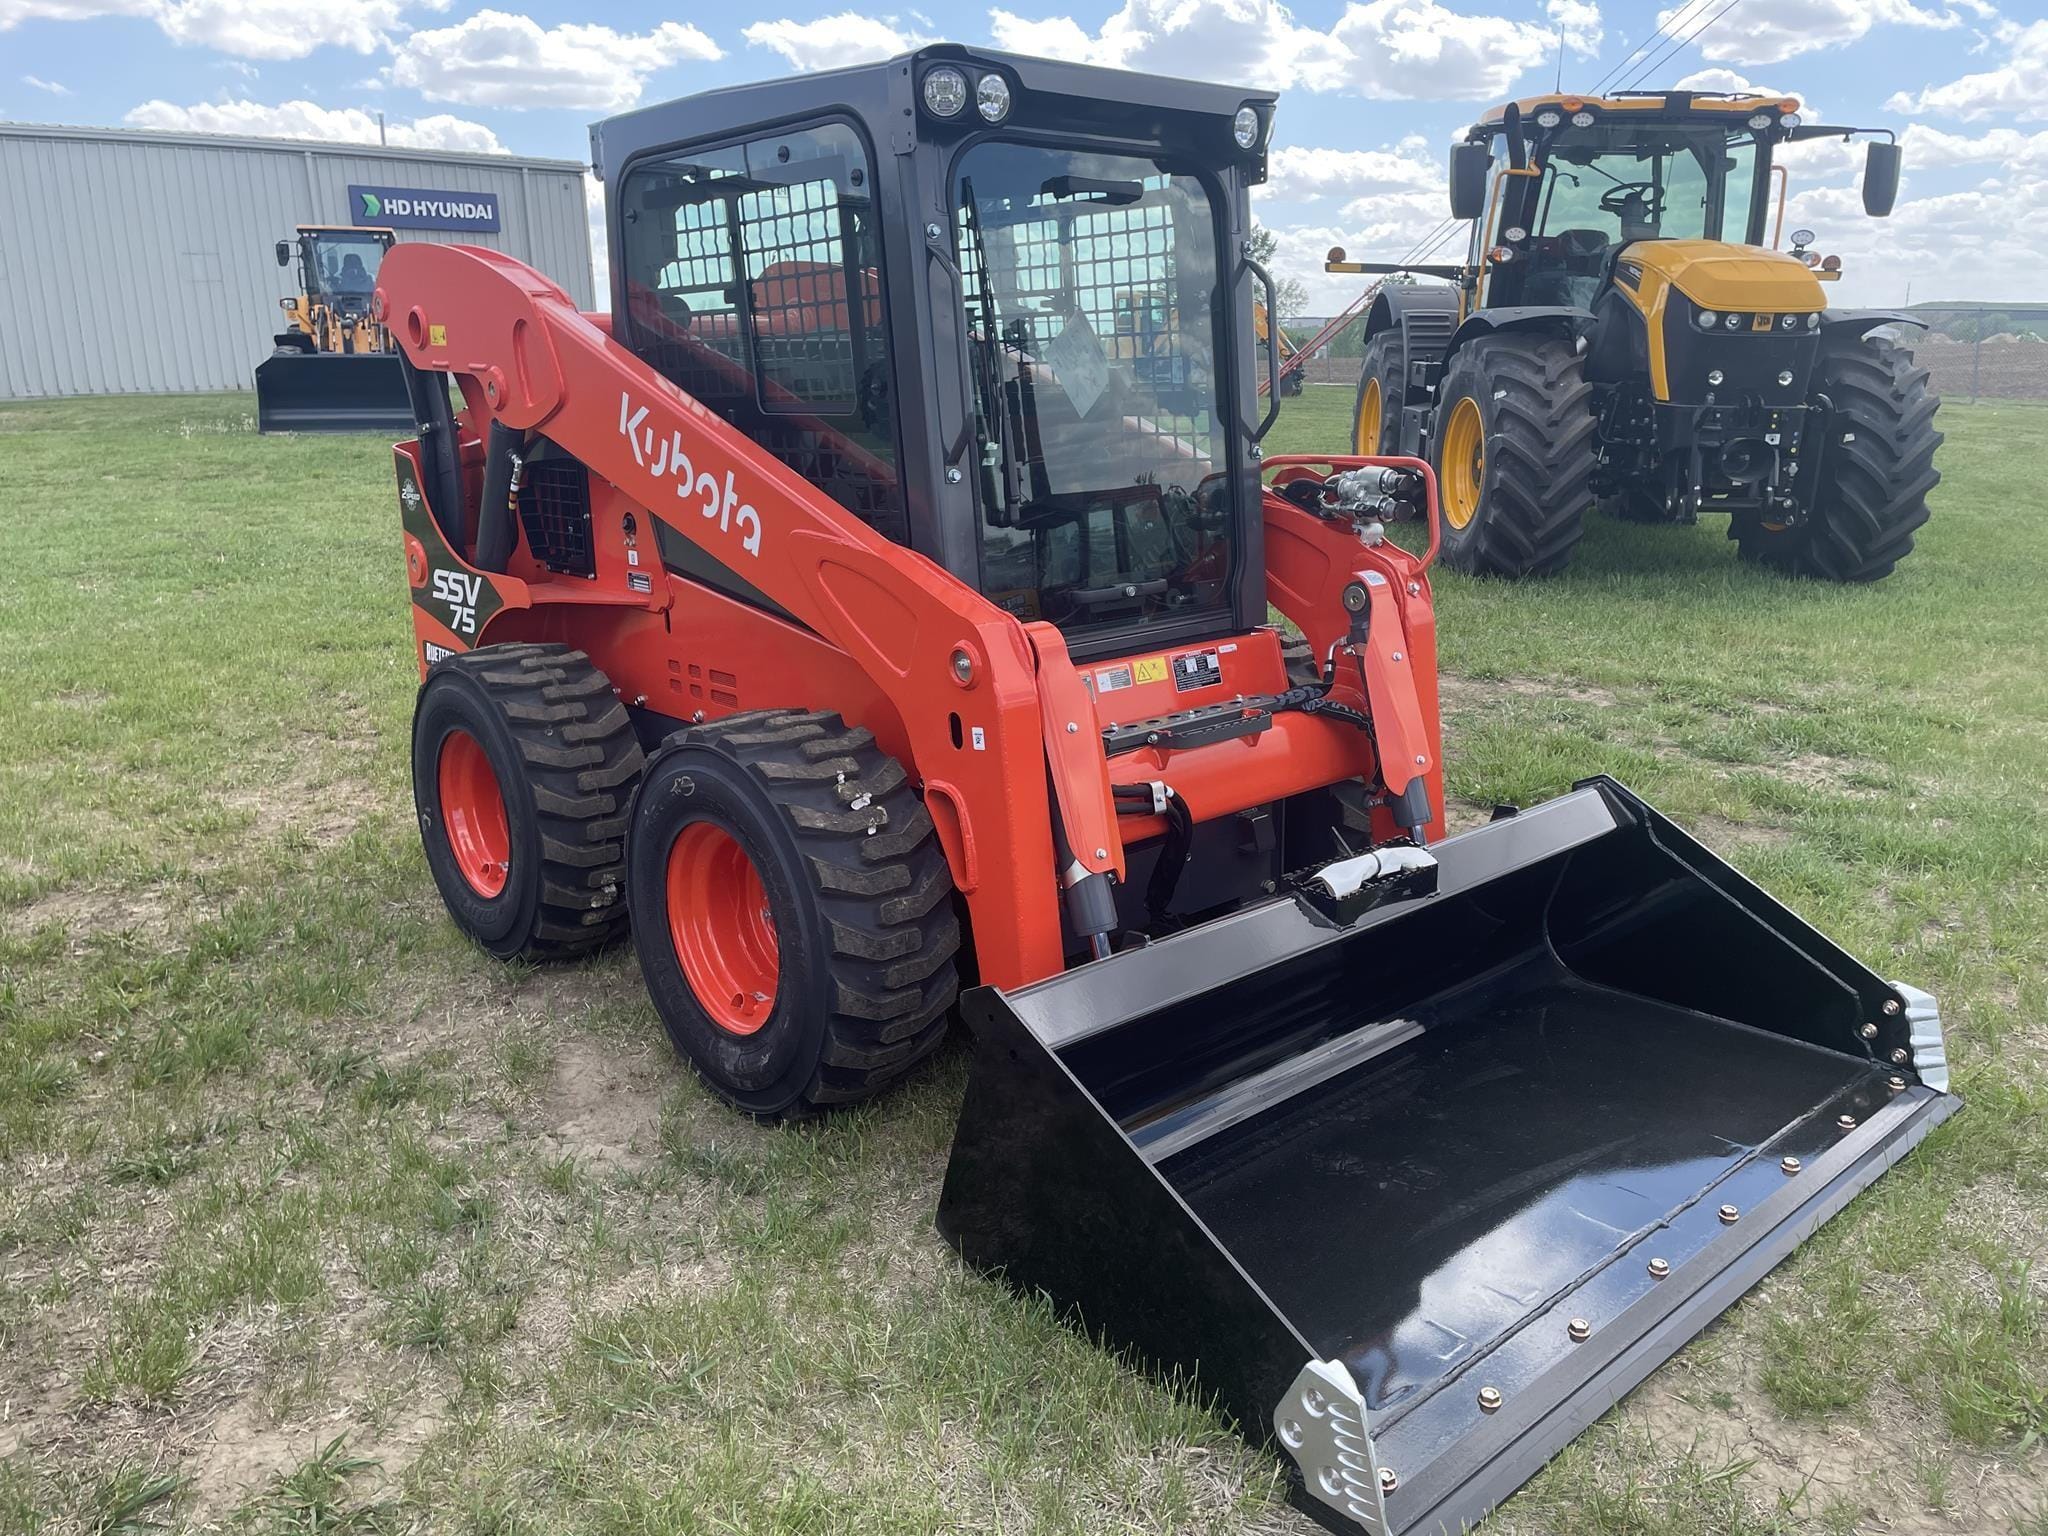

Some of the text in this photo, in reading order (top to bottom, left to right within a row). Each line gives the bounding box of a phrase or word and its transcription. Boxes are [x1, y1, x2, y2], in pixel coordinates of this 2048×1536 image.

[383, 198, 493, 220] HD HYUNDAI
[619, 391, 762, 558] Kubota
[432, 568, 482, 607] SSV
[449, 604, 476, 634] 75
